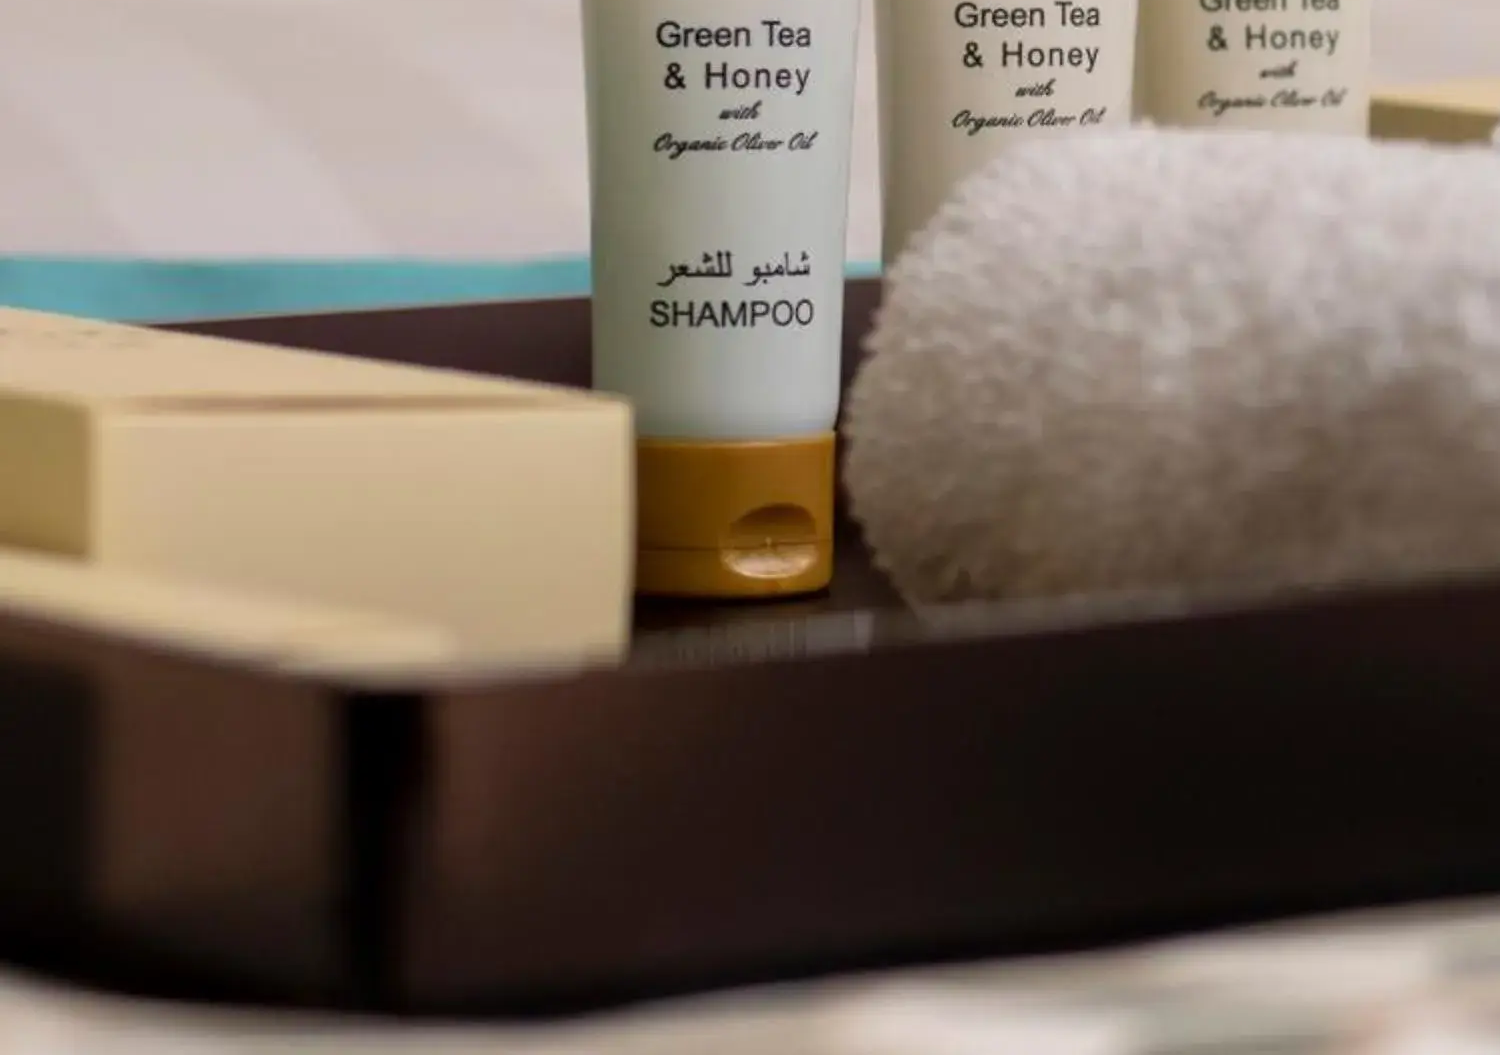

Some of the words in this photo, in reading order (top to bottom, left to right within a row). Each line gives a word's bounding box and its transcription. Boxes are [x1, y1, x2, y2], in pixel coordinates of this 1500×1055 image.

[954, 1, 1045, 28] Green
[1054, 1, 1100, 27] Tea
[656, 20, 751, 48] Green
[761, 20, 812, 47] Tea
[1206, 24, 1229, 52] &
[1244, 23, 1341, 56] Honey
[962, 41, 984, 68] &
[1001, 41, 1100, 74] Honey
[664, 61, 687, 89] &
[705, 61, 811, 95] Honey
[1014, 78, 1056, 97] with
[718, 100, 763, 120] with
[951, 109, 1025, 136] Organic
[653, 132, 729, 160] Organic
[788, 131, 818, 151] Oil
[656, 250, 734, 287] للشعر
[742, 250, 811, 287] شامبو
[649, 298, 815, 328] SHAMPOO
